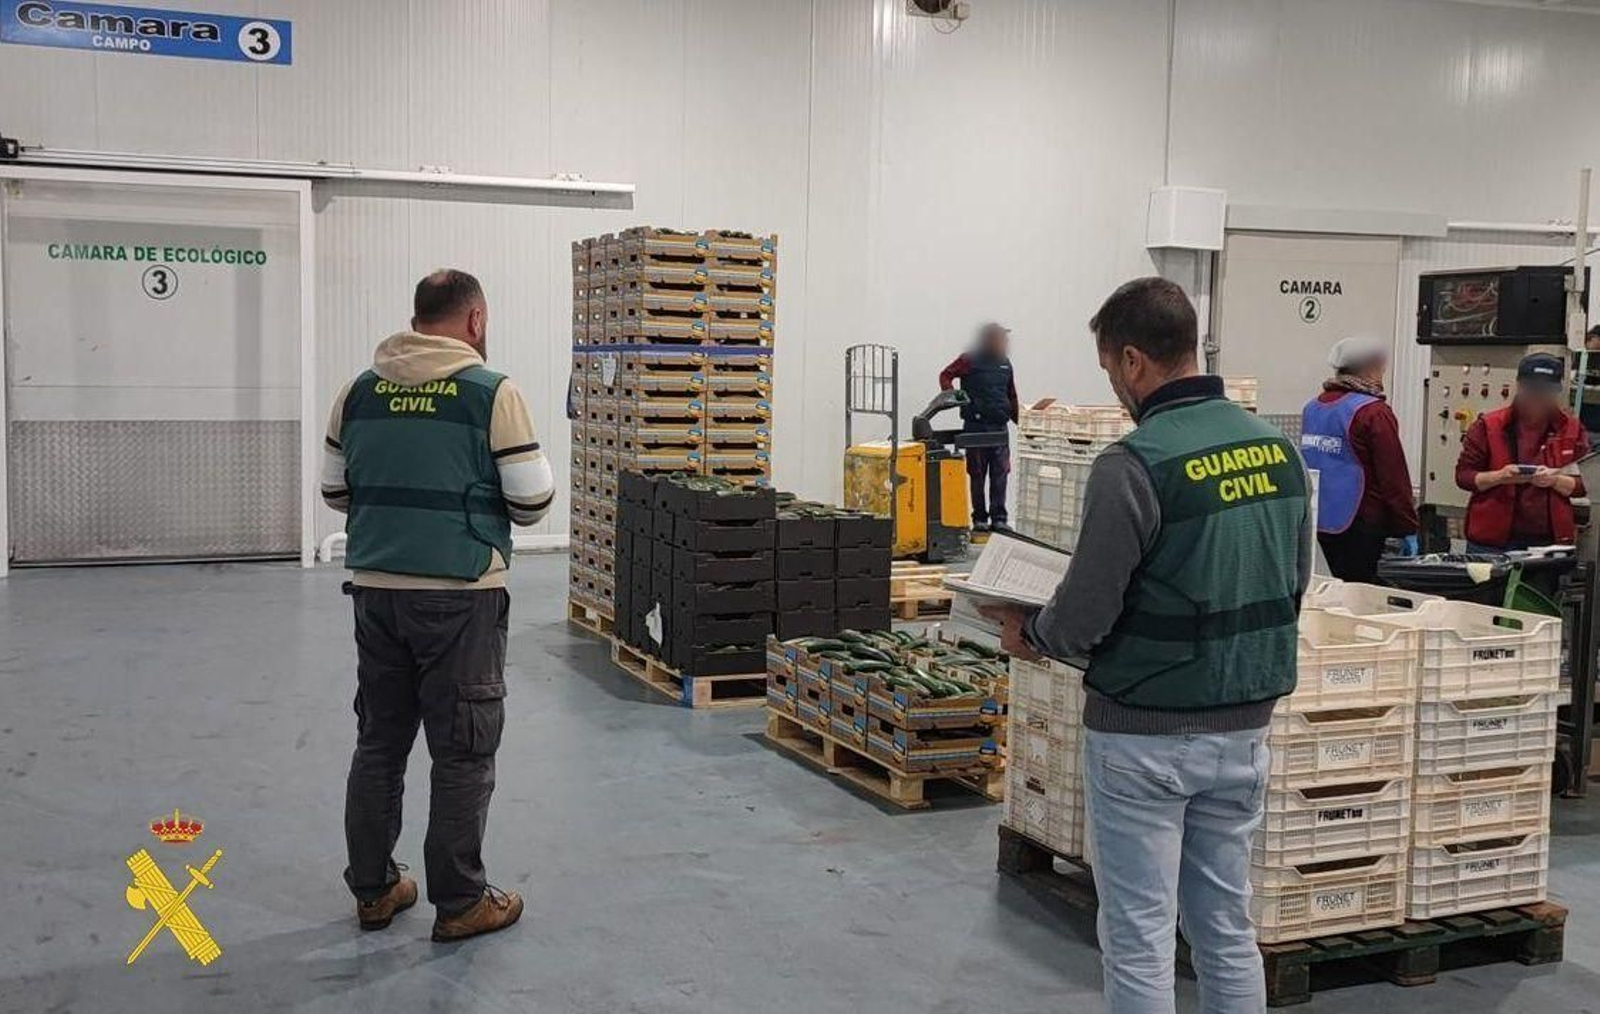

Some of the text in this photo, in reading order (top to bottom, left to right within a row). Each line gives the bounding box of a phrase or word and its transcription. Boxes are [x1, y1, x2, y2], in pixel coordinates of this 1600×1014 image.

[16, 1, 271, 55] Camara 3
[92, 35, 151, 51] CAMPO
[48, 243, 267, 265] CAMARA DE ECOLÓGICO
[152, 269, 168, 295] 3
[1280, 279, 1343, 296] CAMARA
[1304, 299, 1316, 320] 2
[389, 397, 436, 412] CIVIL
[1185, 443, 1288, 480] GUARDIA
[1220, 472, 1278, 501] CIVIL
